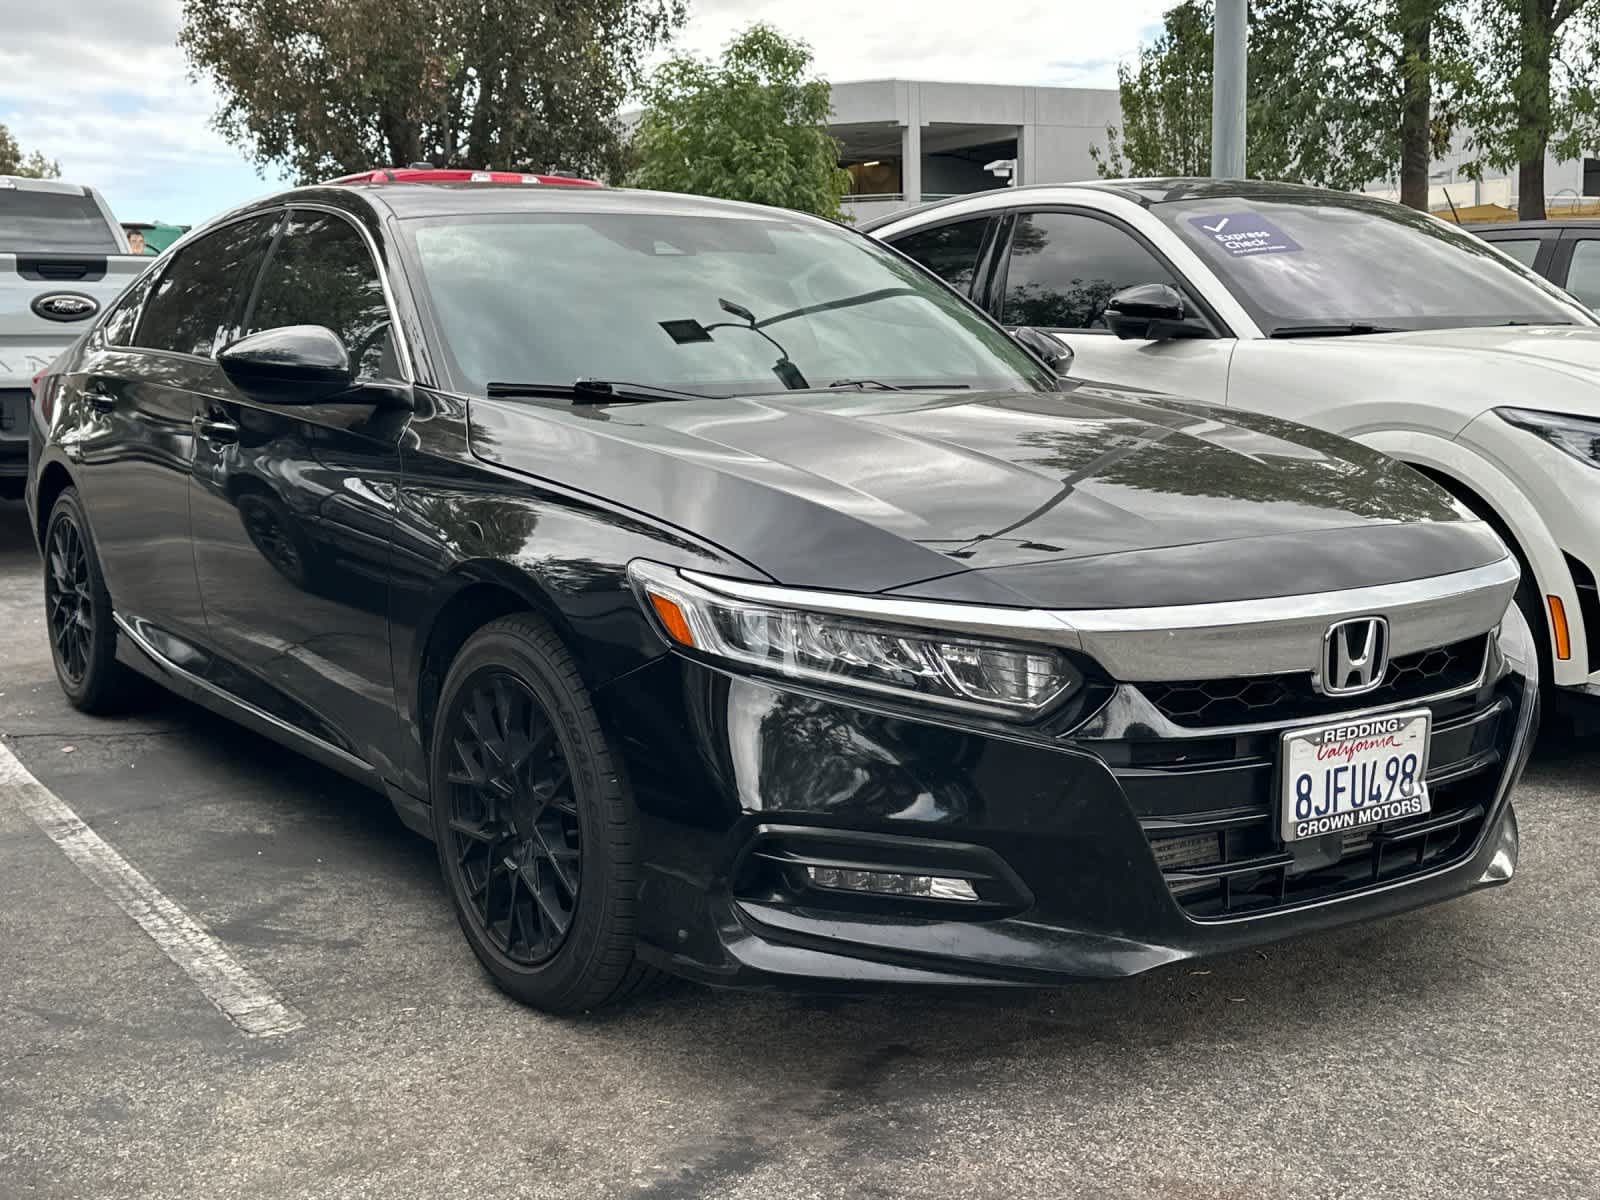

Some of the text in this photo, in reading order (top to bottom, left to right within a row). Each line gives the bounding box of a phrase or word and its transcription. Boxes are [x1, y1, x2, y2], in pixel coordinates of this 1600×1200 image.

[1215, 231, 1270, 241] Express
[1225, 239, 1268, 249] Check
[1324, 719, 1398, 743] REDDING
[1317, 735, 1401, 761] California
[1295, 753, 1417, 820] 8JFU498
[1297, 798, 1421, 837] CROWN MOTORS
